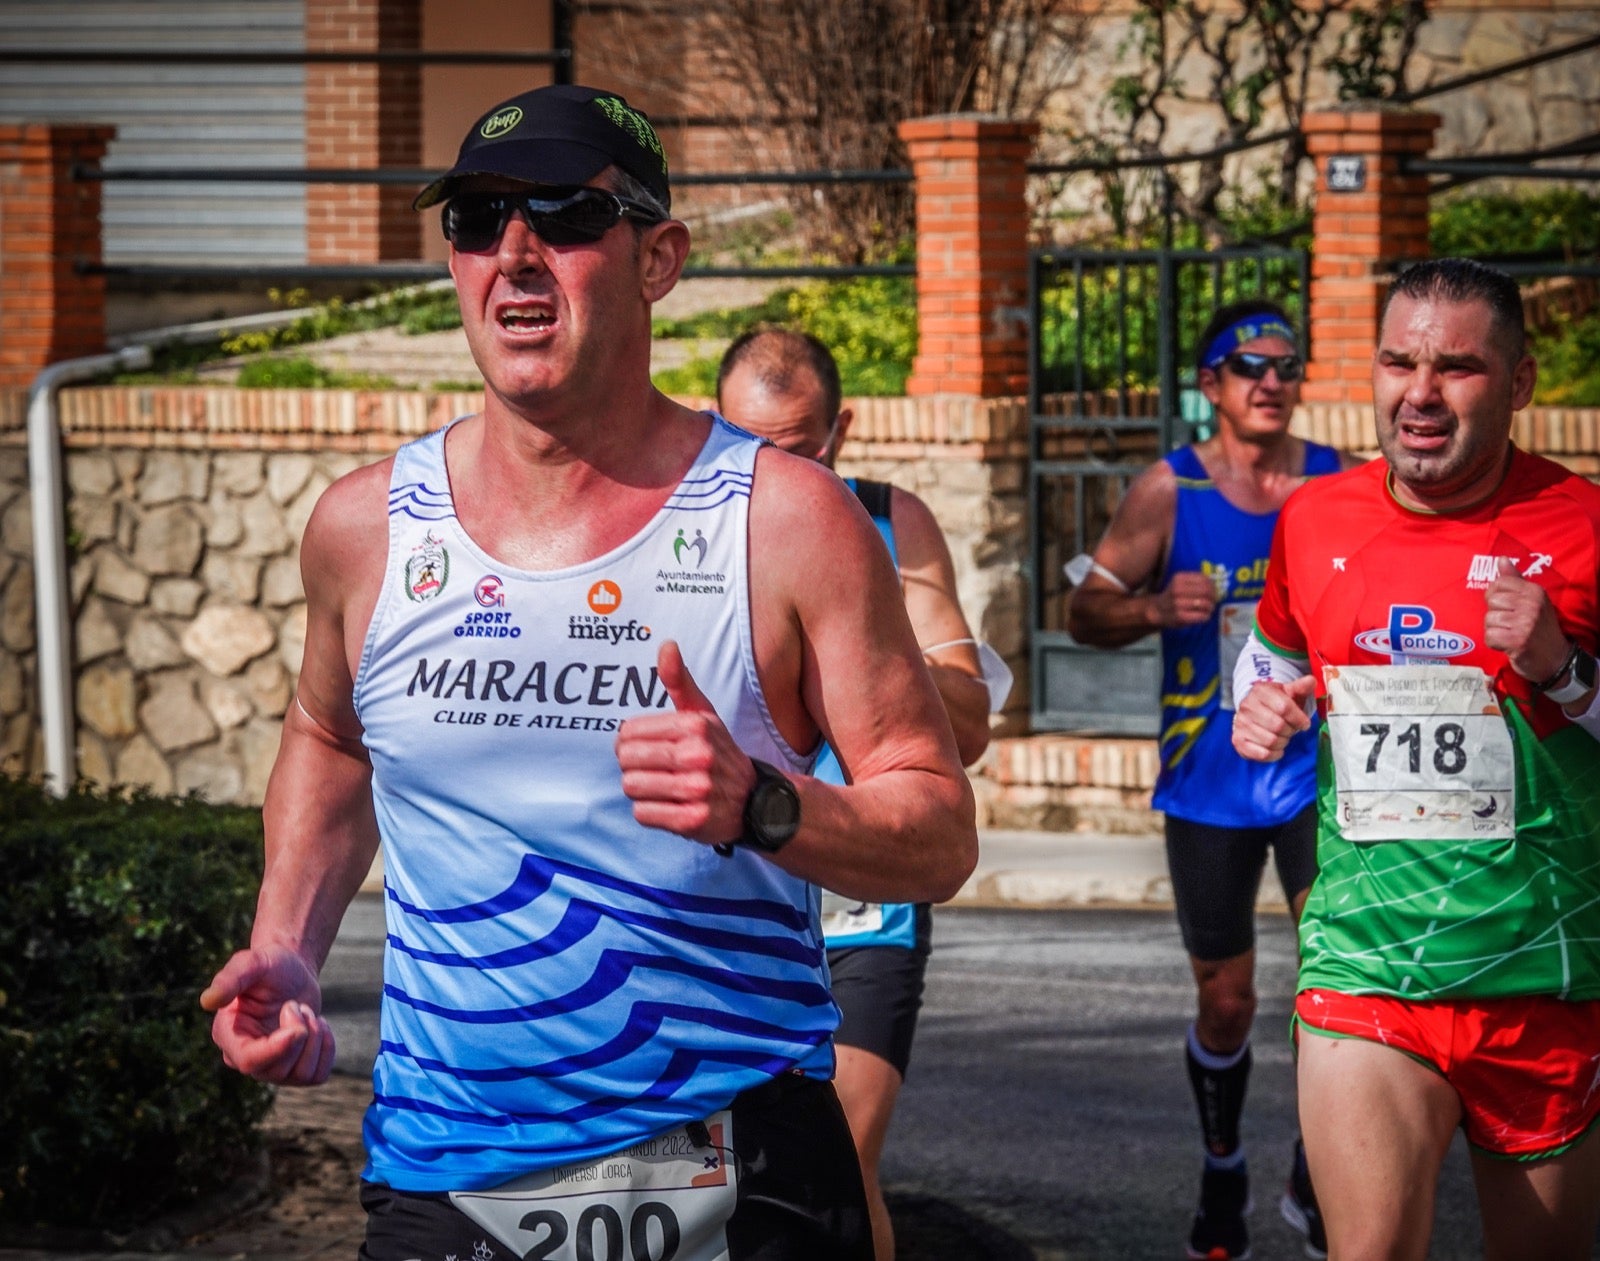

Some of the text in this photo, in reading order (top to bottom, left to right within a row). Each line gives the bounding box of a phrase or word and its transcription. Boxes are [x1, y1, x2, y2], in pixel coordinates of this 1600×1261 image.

[485, 110, 519, 135] Buff
[655, 581, 725, 595] de Maracena
[656, 568, 726, 584] Ayuntamiento
[464, 612, 512, 624] SPORT
[569, 615, 609, 625] grupo
[453, 626, 522, 638] GARRIDO
[568, 620, 652, 646] mayfo
[406, 658, 669, 708] MARACEN
[433, 709, 625, 733] CLUB DE ATLETIS
[1360, 722, 1467, 775] 718
[662, 1134, 694, 1156] 2022
[552, 1160, 634, 1184] UNIVERSO LORCA
[518, 1201, 680, 1261] 200
